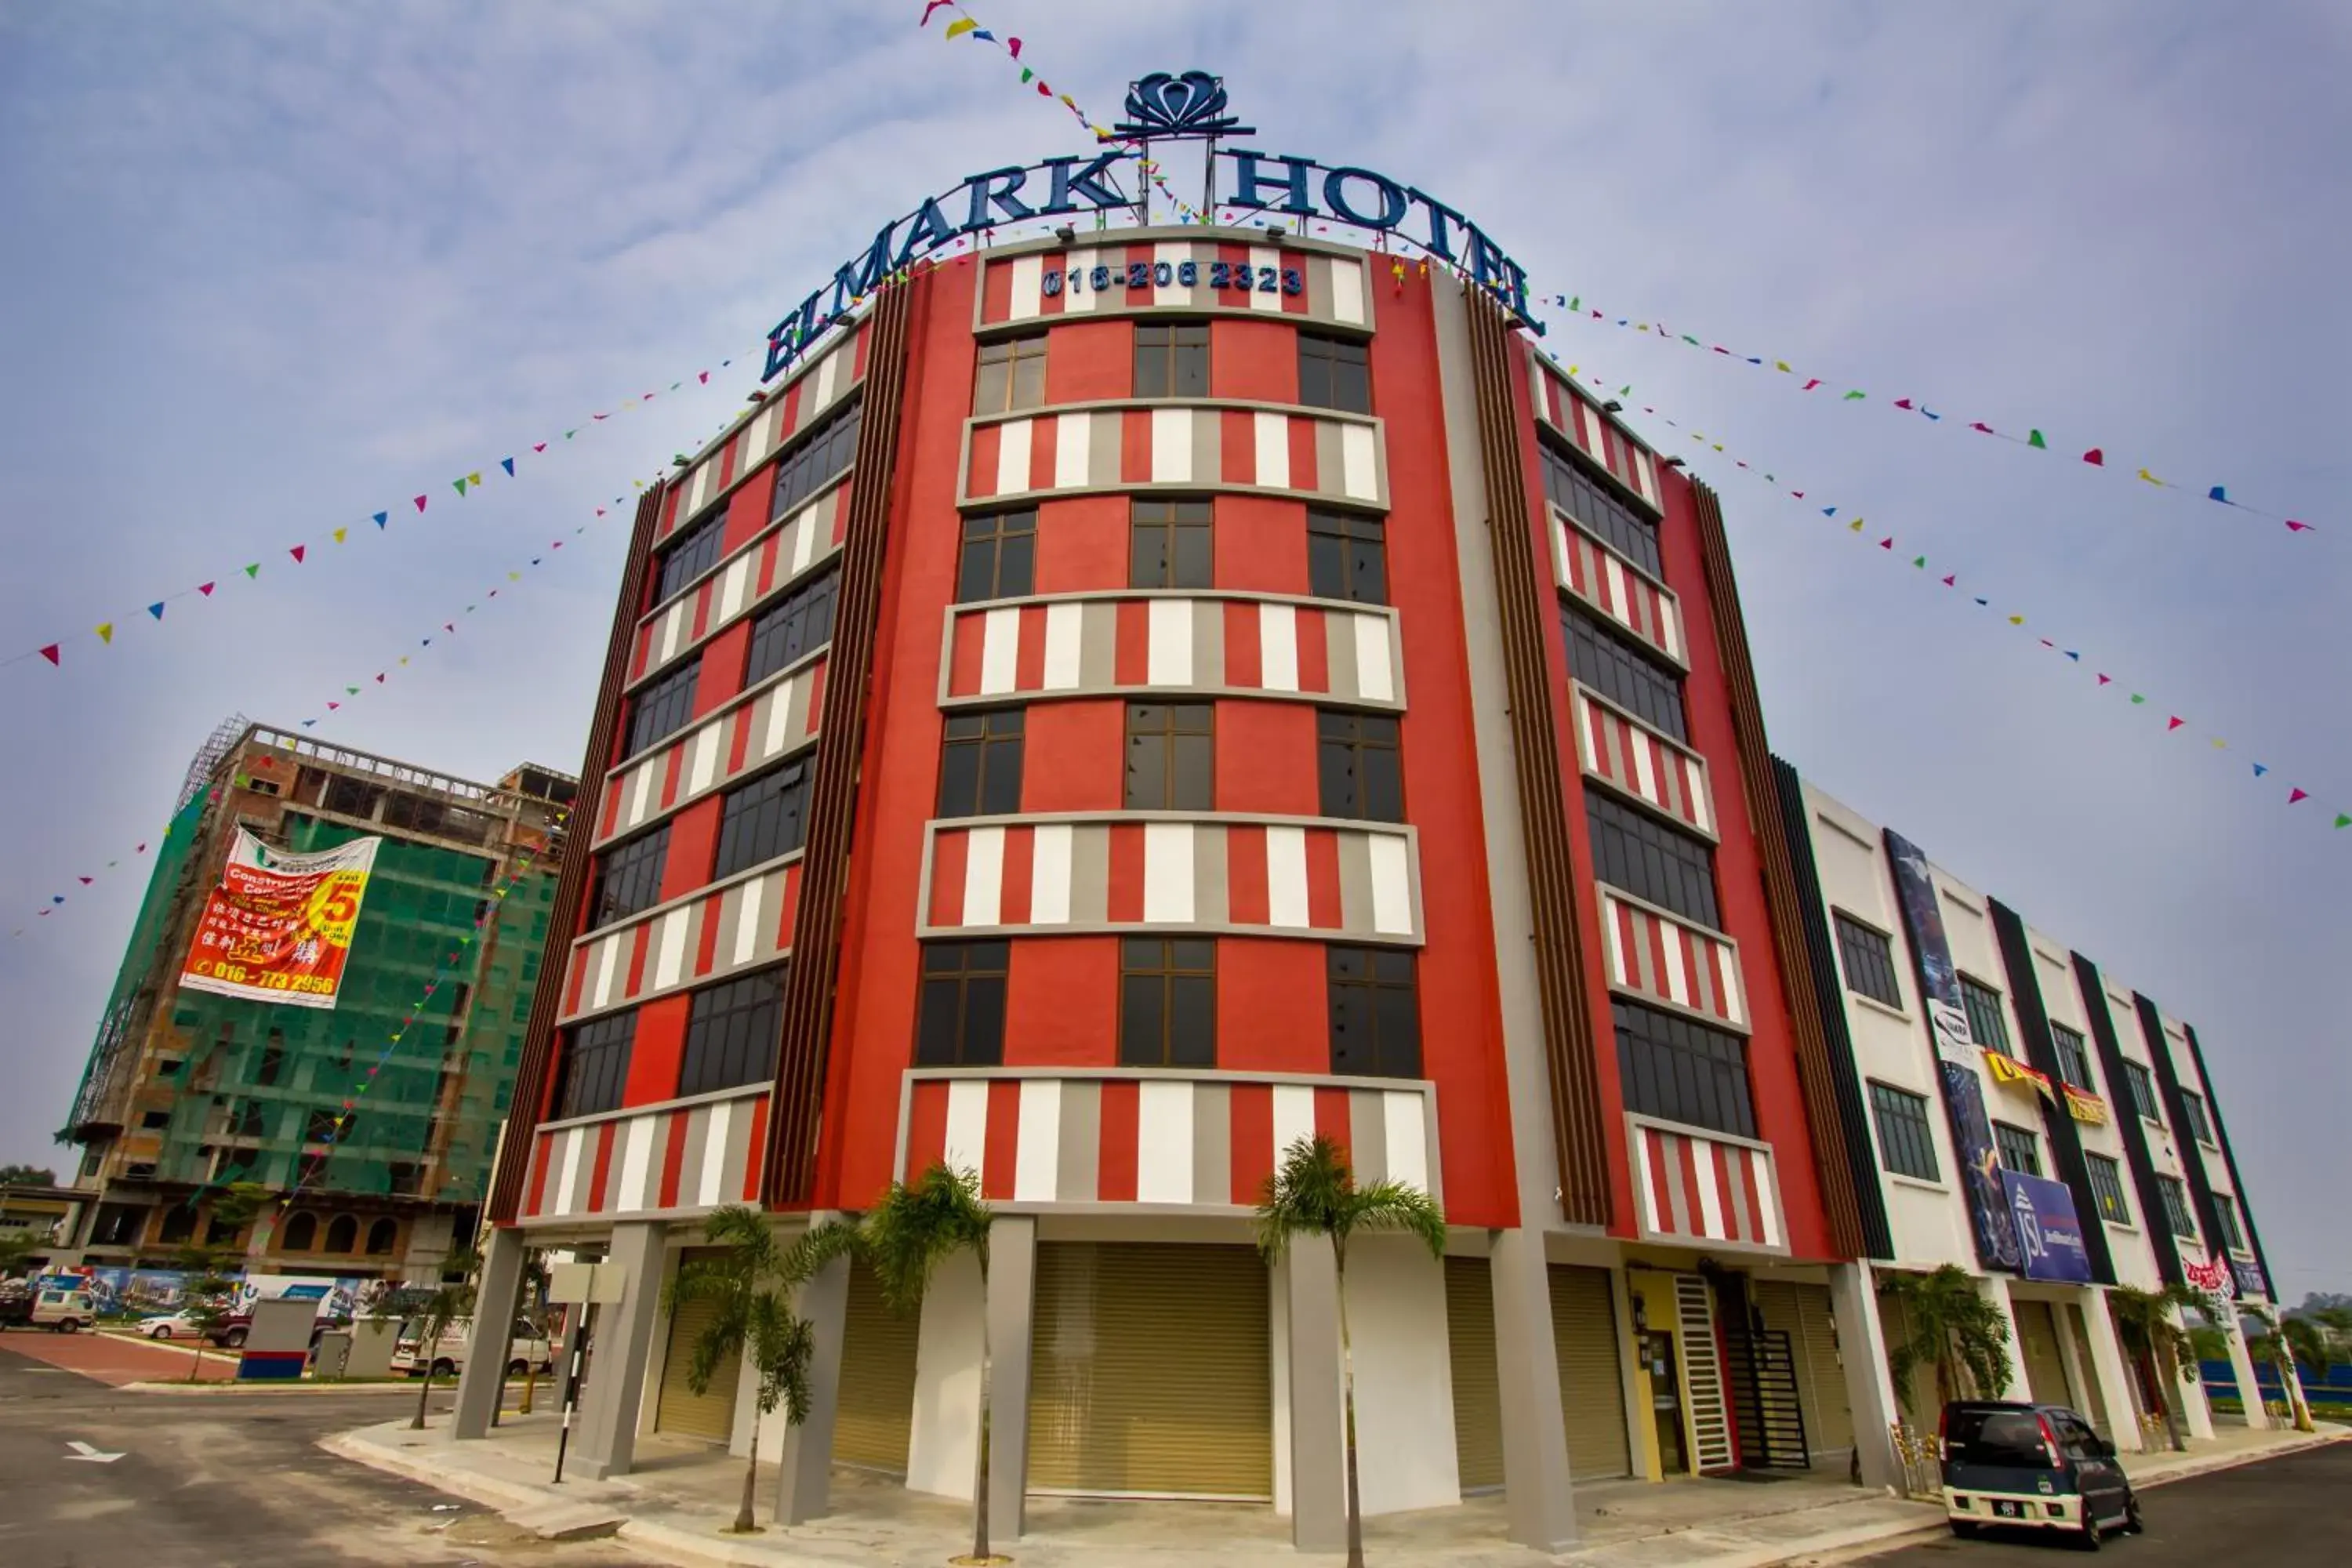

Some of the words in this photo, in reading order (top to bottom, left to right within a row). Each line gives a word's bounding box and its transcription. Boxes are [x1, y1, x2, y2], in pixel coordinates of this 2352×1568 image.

[760, 151, 1135, 383] ELMARK
[1228, 147, 1546, 338] HOTEL
[1042, 261, 1197, 296] 016-206
[1210, 262, 1303, 296] 2323
[321, 883, 361, 923] 5
